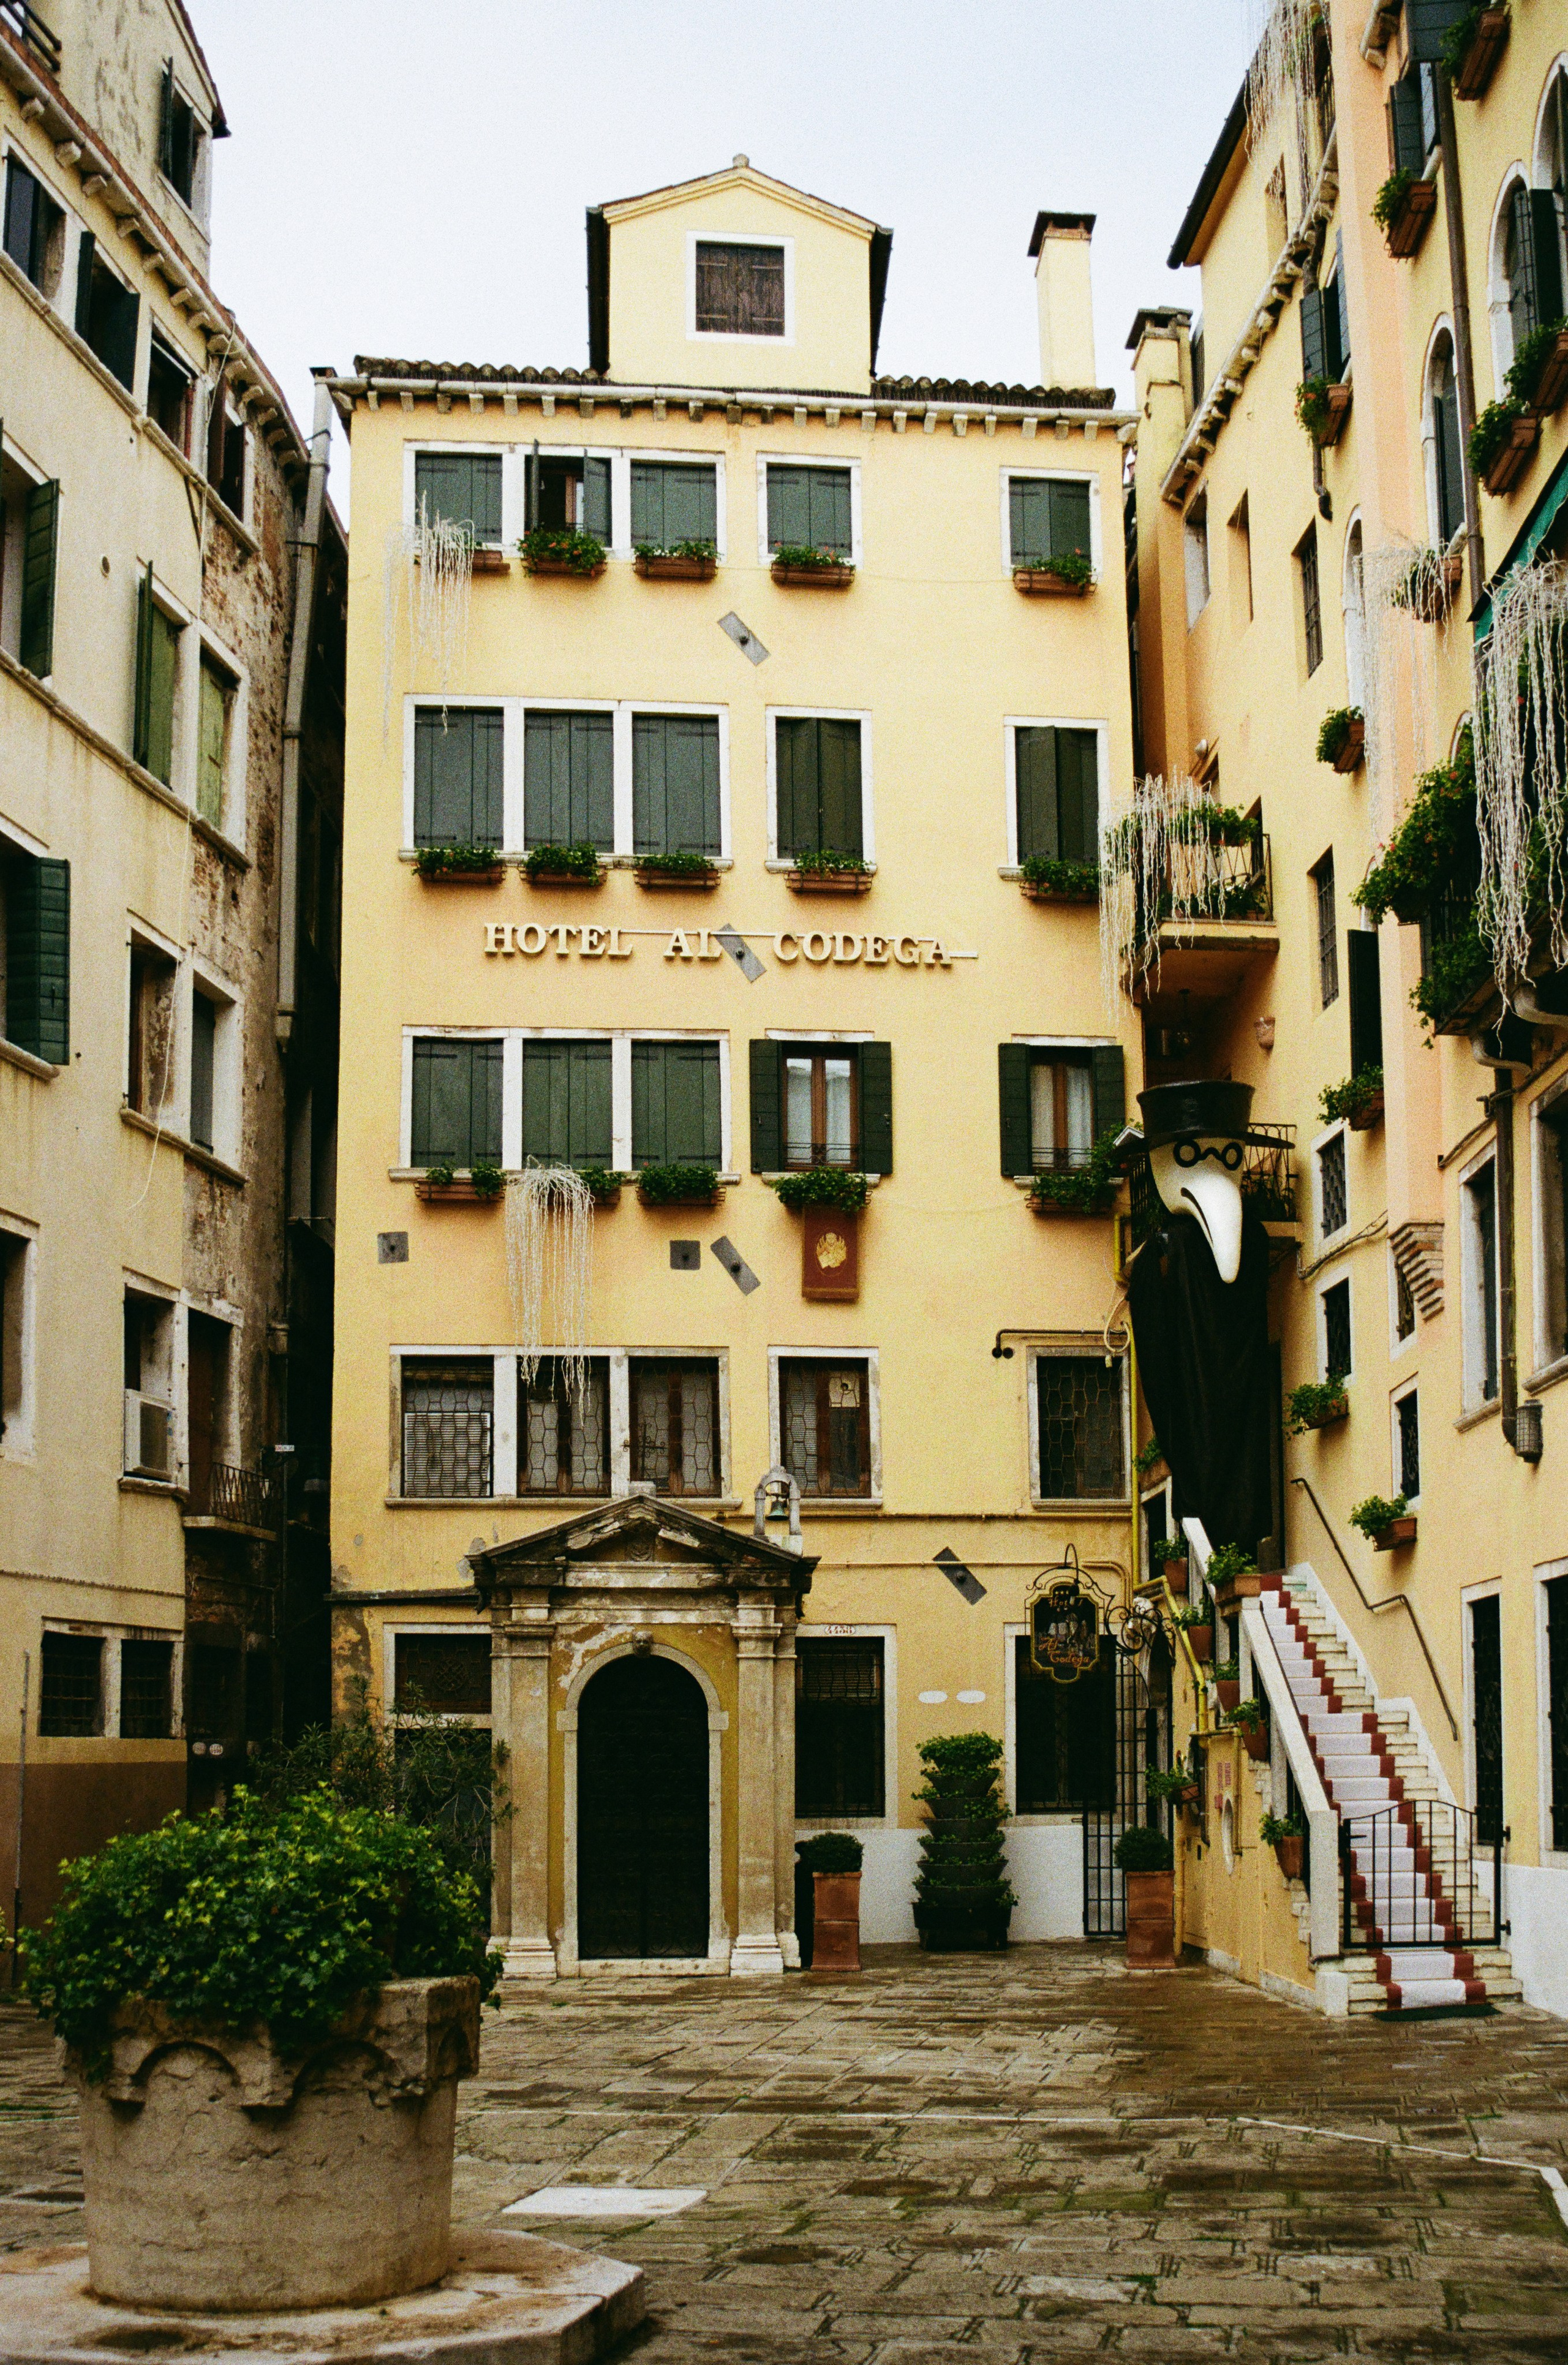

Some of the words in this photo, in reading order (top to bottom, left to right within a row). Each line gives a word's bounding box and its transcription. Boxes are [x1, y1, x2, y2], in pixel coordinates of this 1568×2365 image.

[484, 922, 633, 956] HOTEL
[663, 927, 724, 958] AL
[772, 930, 953, 965] CODEGA
[1048, 1596, 1084, 1607] Hotl
[1047, 1650, 1090, 1667] Codega
